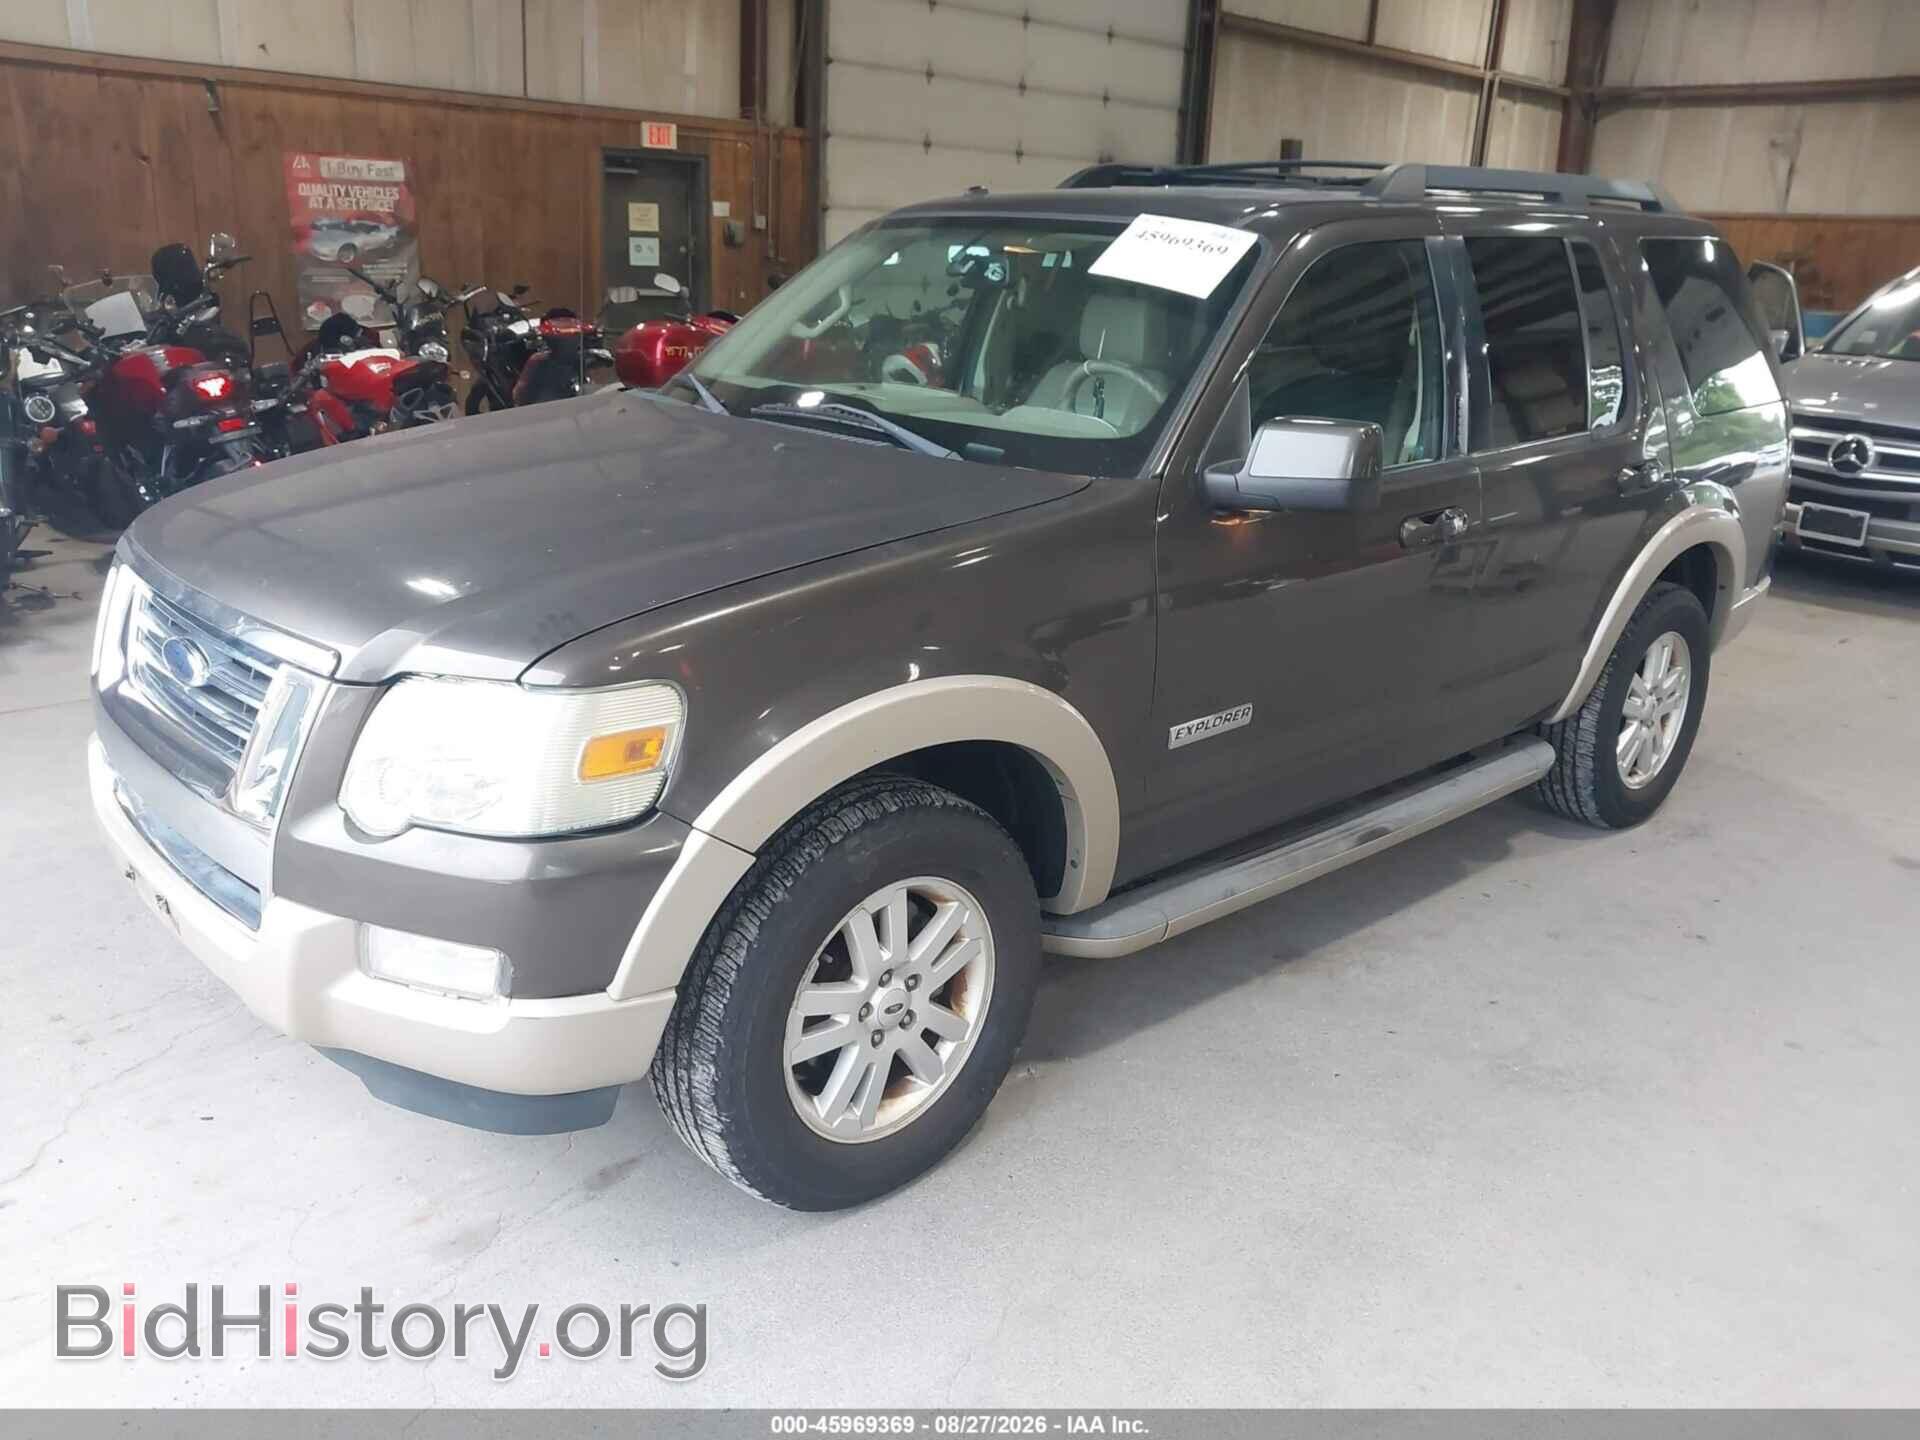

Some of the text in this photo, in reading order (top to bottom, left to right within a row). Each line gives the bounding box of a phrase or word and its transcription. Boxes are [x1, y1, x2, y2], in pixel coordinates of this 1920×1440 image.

[336, 160, 362, 179] Buy
[298, 183, 400, 201] QUALITY VEHICLES
[309, 196, 323, 209] AT
[326, 197, 335, 209] A
[337, 197, 357, 211] SET
[1174, 706, 1251, 740] EXPLORER
